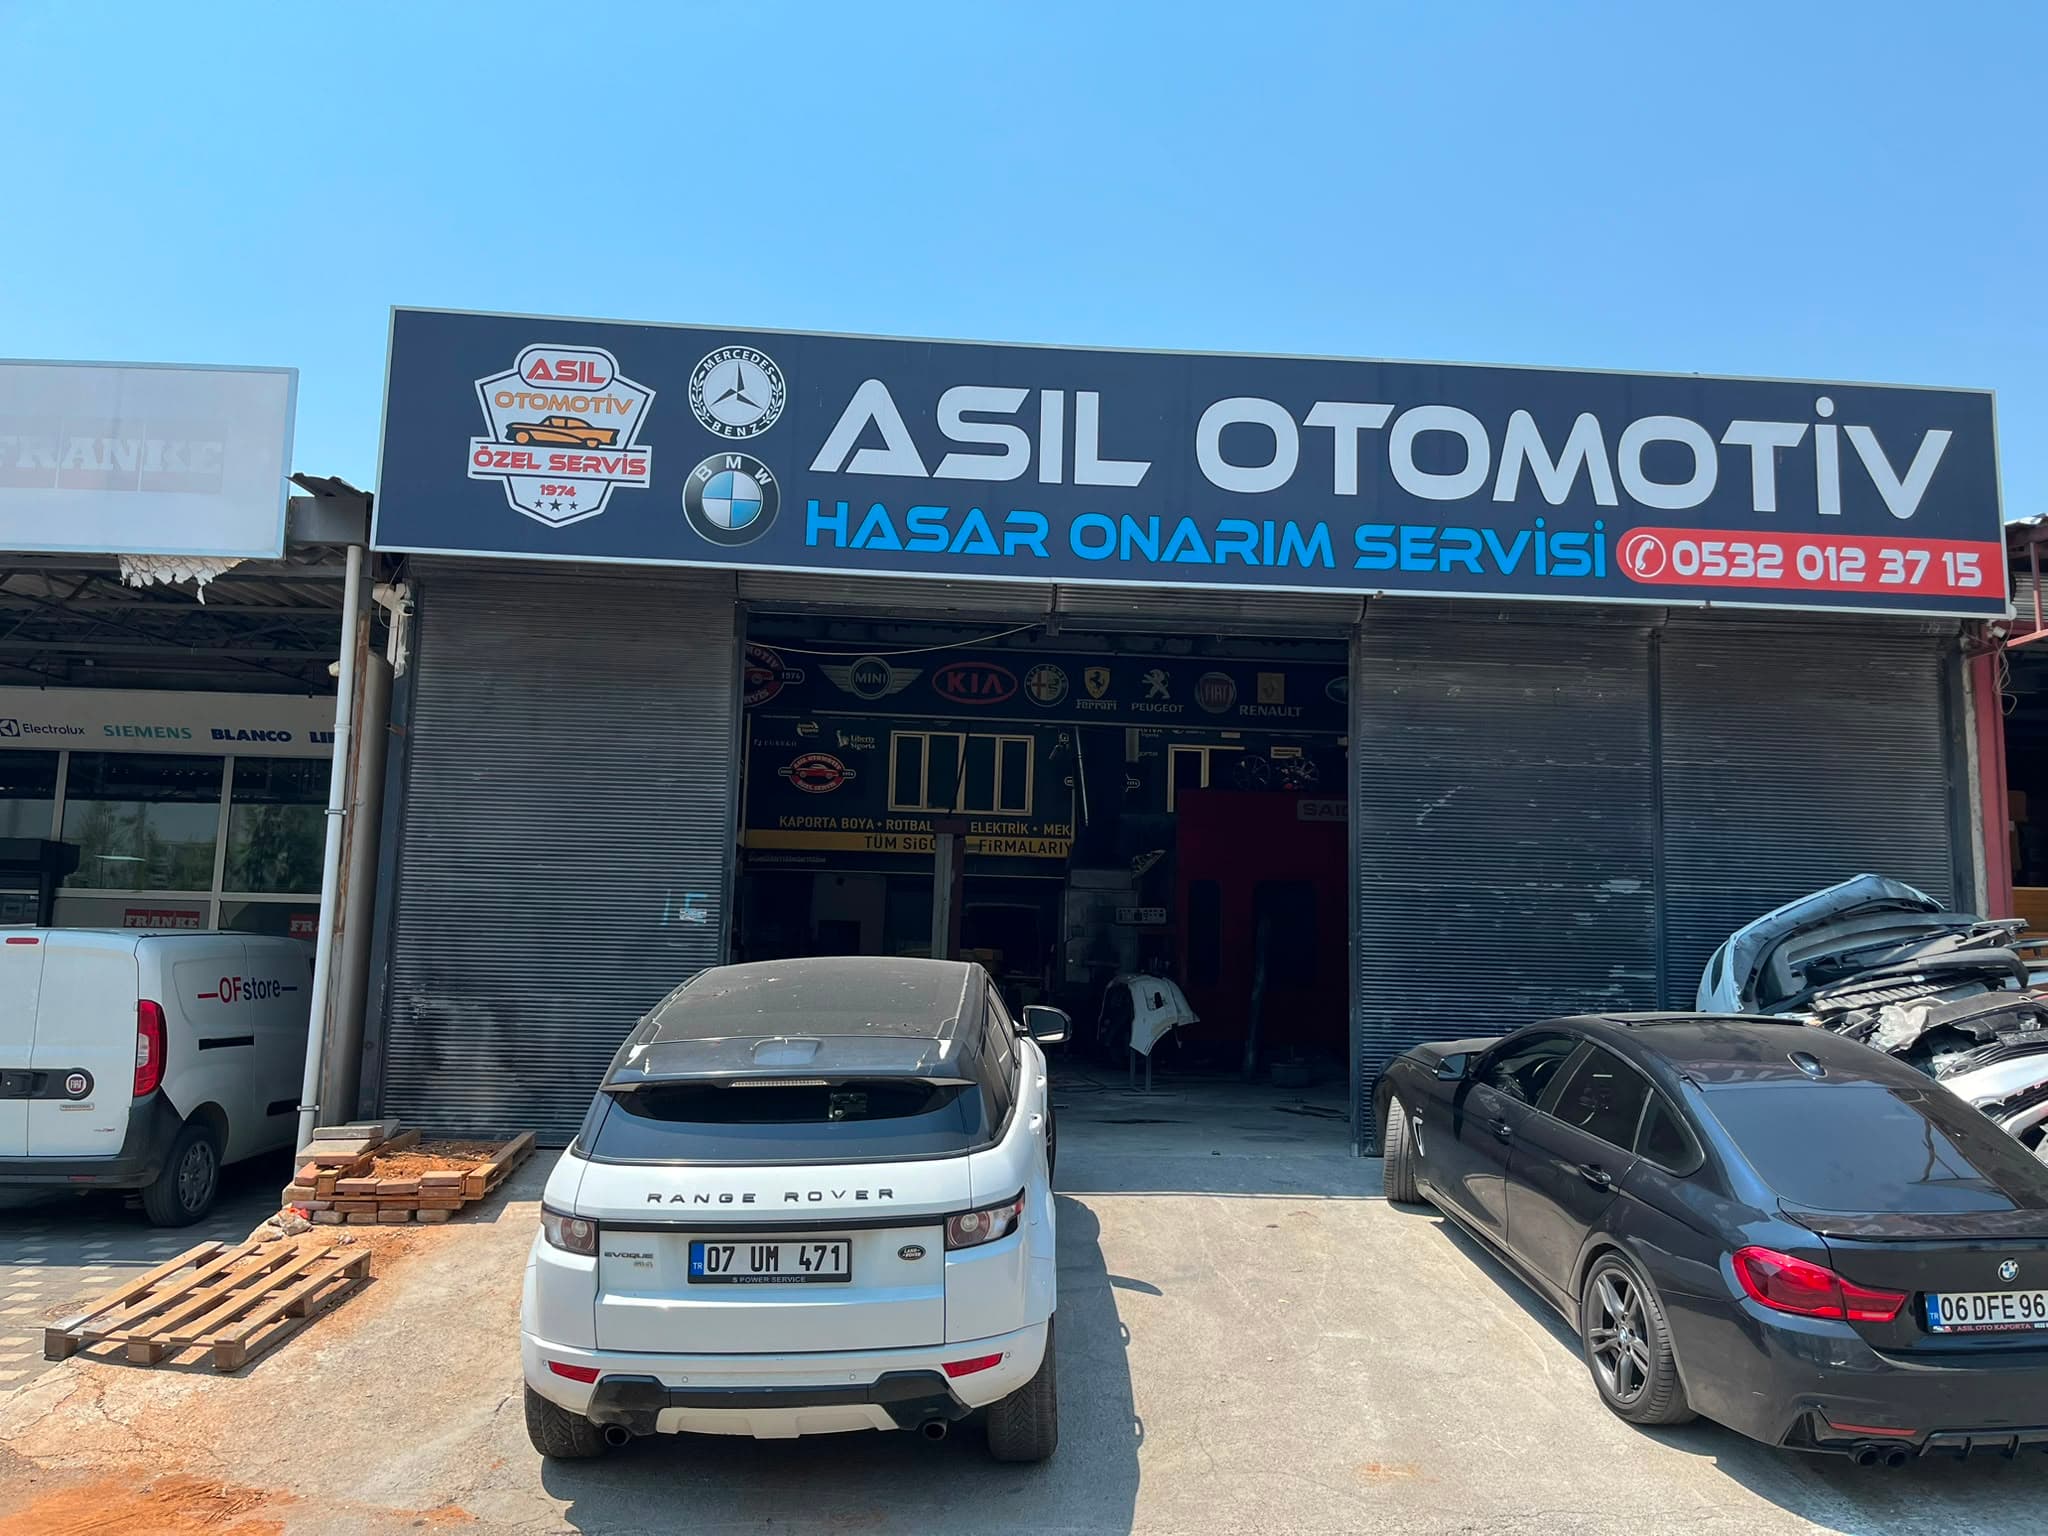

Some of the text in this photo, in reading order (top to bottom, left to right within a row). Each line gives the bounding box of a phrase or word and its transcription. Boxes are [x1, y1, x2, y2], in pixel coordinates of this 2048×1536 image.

[525, 357, 607, 384] ASIL
[703, 349, 776, 377] MERCEDES
[494, 391, 634, 416] OTOMOTİV
[711, 421, 762, 438] BENZ
[808, 378, 1954, 520] ASIL OTOMOTİV
[473, 444, 647, 477] ÖZEL SERVİS
[696, 456, 772, 486] BMW
[539, 484, 577, 498] 1974
[805, 499, 1607, 578] HASAR ONARIM SERVİSİ
[1671, 540, 1983, 588] 0532 012 37 15
[782, 672, 801, 681] 1974
[855, 672, 886, 685] MINI
[946, 672, 1005, 694] KIA
[1200, 686, 1232, 705] FIAT
[1075, 699, 1119, 711] Ferrari
[1131, 703, 1184, 714] PEUGEOT
[1239, 704, 1304, 718] RENAULT
[23, 723, 85, 736] Electrolux
[103, 725, 192, 740] SIEMENS
[211, 728, 292, 743] BLANCO
[779, 815, 837, 829] KAPORTA
[841, 817, 874, 831] BOYA
[885, 819, 934, 832] ROTBAL
[970, 821, 1029, 835] ELEKTRİK
[864, 833, 897, 849] TÜM
[125, 916, 199, 929] FRANKE
[289, 920, 319, 933] FR
[219, 977, 281, 1003] OFstore
[647, 1188, 894, 1204] RANGE ROVER
[604, 1251, 654, 1260] EVOQUE
[707, 1245, 840, 1273] 07 UM 471
[692, 1262, 703, 1270] TR
[1941, 1293, 2046, 1321] 06 DFE 96
[1929, 1312, 1939, 1321] TR
[1956, 1325, 1975, 1333] ASIL
[1975, 1324, 1993, 1332] OTO
[1993, 1323, 2032, 1331] KAPORTA
